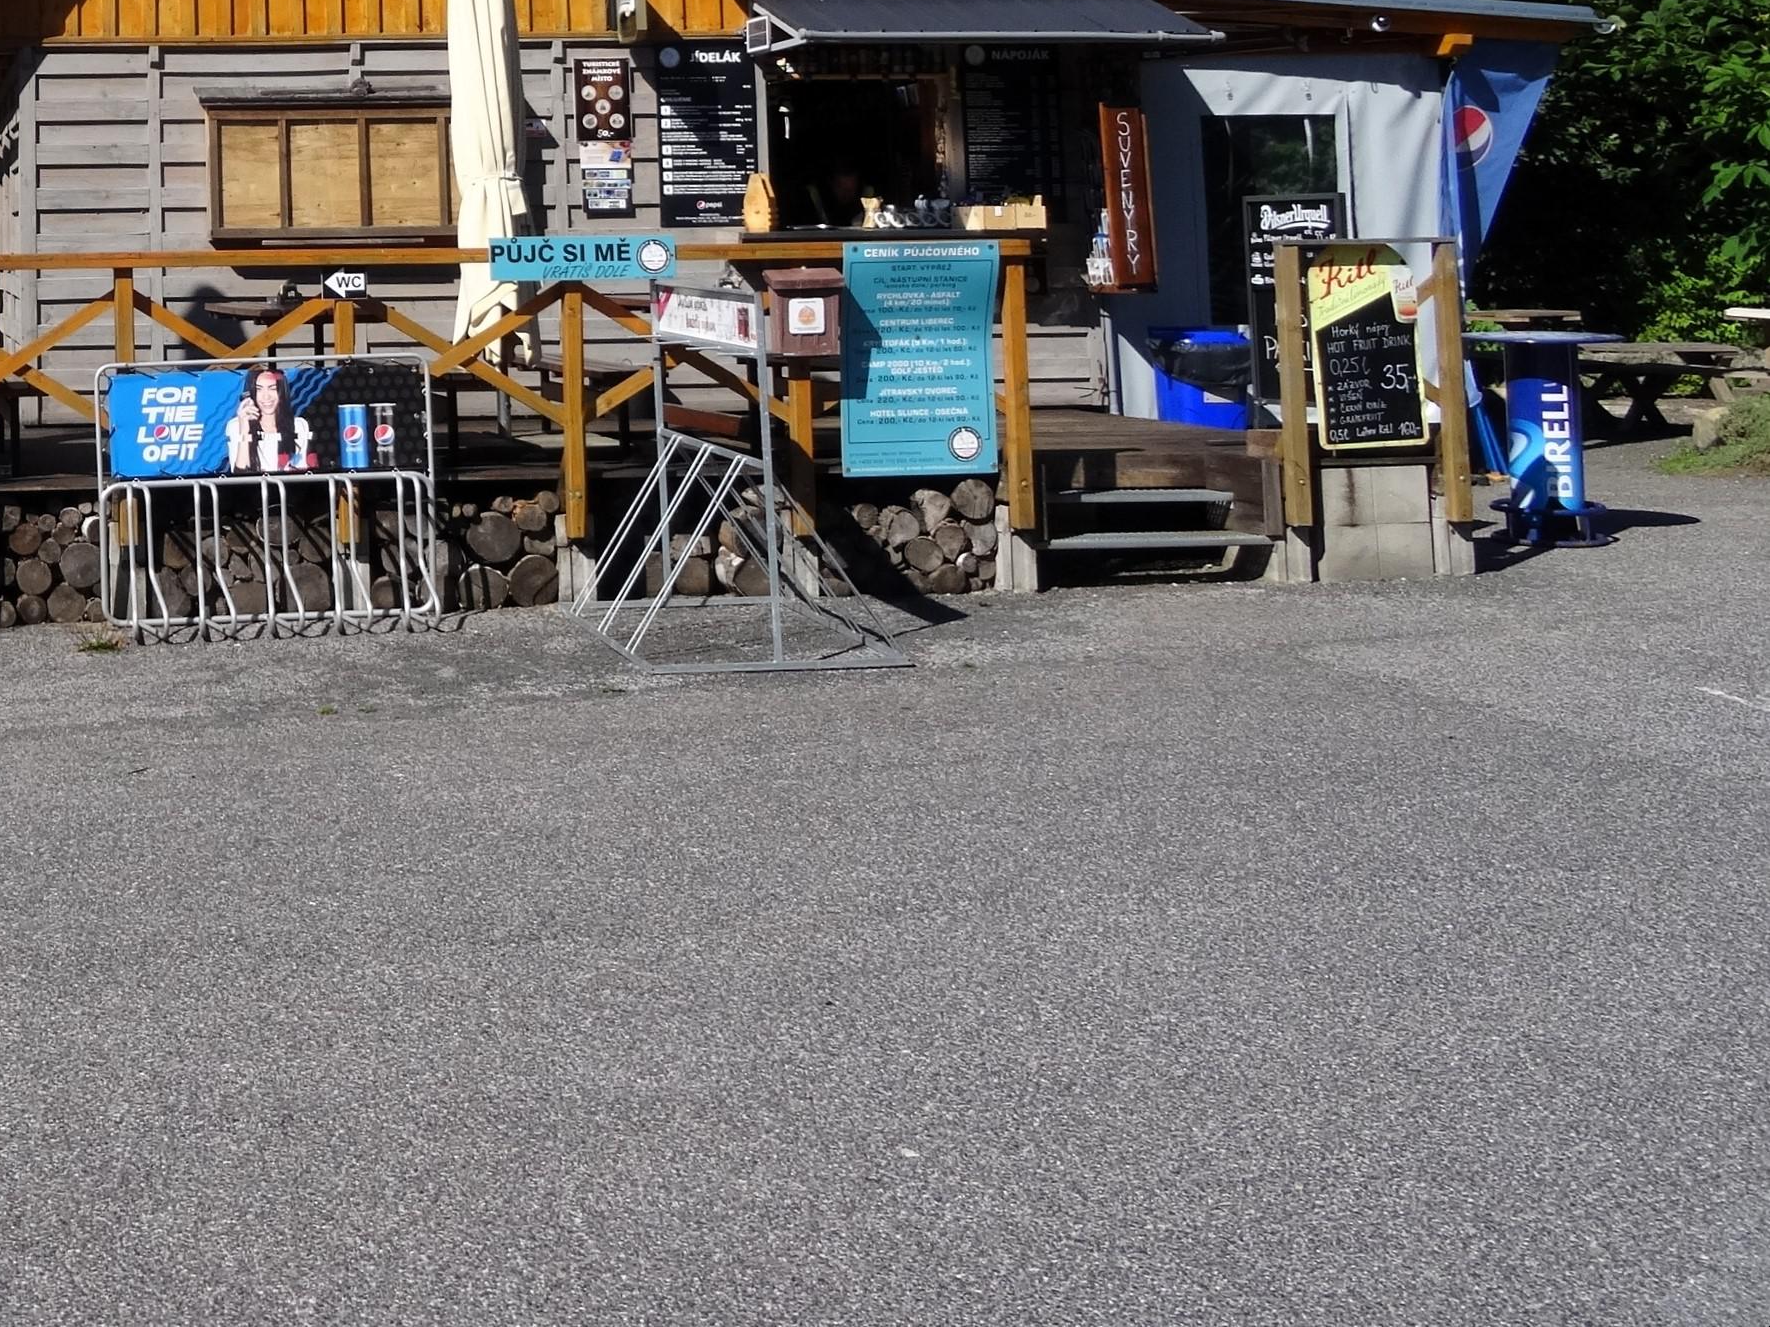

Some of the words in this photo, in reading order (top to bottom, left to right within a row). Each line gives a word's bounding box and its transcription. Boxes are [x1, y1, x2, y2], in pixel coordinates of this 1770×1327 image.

[1116, 111, 1140, 275] SUVENYRY
[490, 237, 554, 263] PŮJČ
[563, 243, 585, 262] SI
[595, 237, 632, 262] MĚ
[863, 247, 899, 259] CENÍK
[903, 245, 980, 258] PŮJČOVNÉHO
[594, 264, 632, 279] DOLE
[1318, 248, 1377, 300] Kitl
[335, 275, 362, 288] WC
[930, 291, 961, 299] ASFALT
[879, 319, 919, 327] CENTRUM
[920, 317, 955, 325] LIBEREC
[1331, 322, 1360, 339] Horký
[1327, 340, 1346, 354] HOT
[1352, 337, 1379, 352] FRUIT
[1382, 334, 1412, 349] DRINK
[140, 385, 197, 405] FOR
[141, 405, 198, 424] THE
[870, 409, 896, 418] HOTEL
[897, 408, 929, 417] SLUNCE
[1541, 384, 1574, 498] BIRELL
